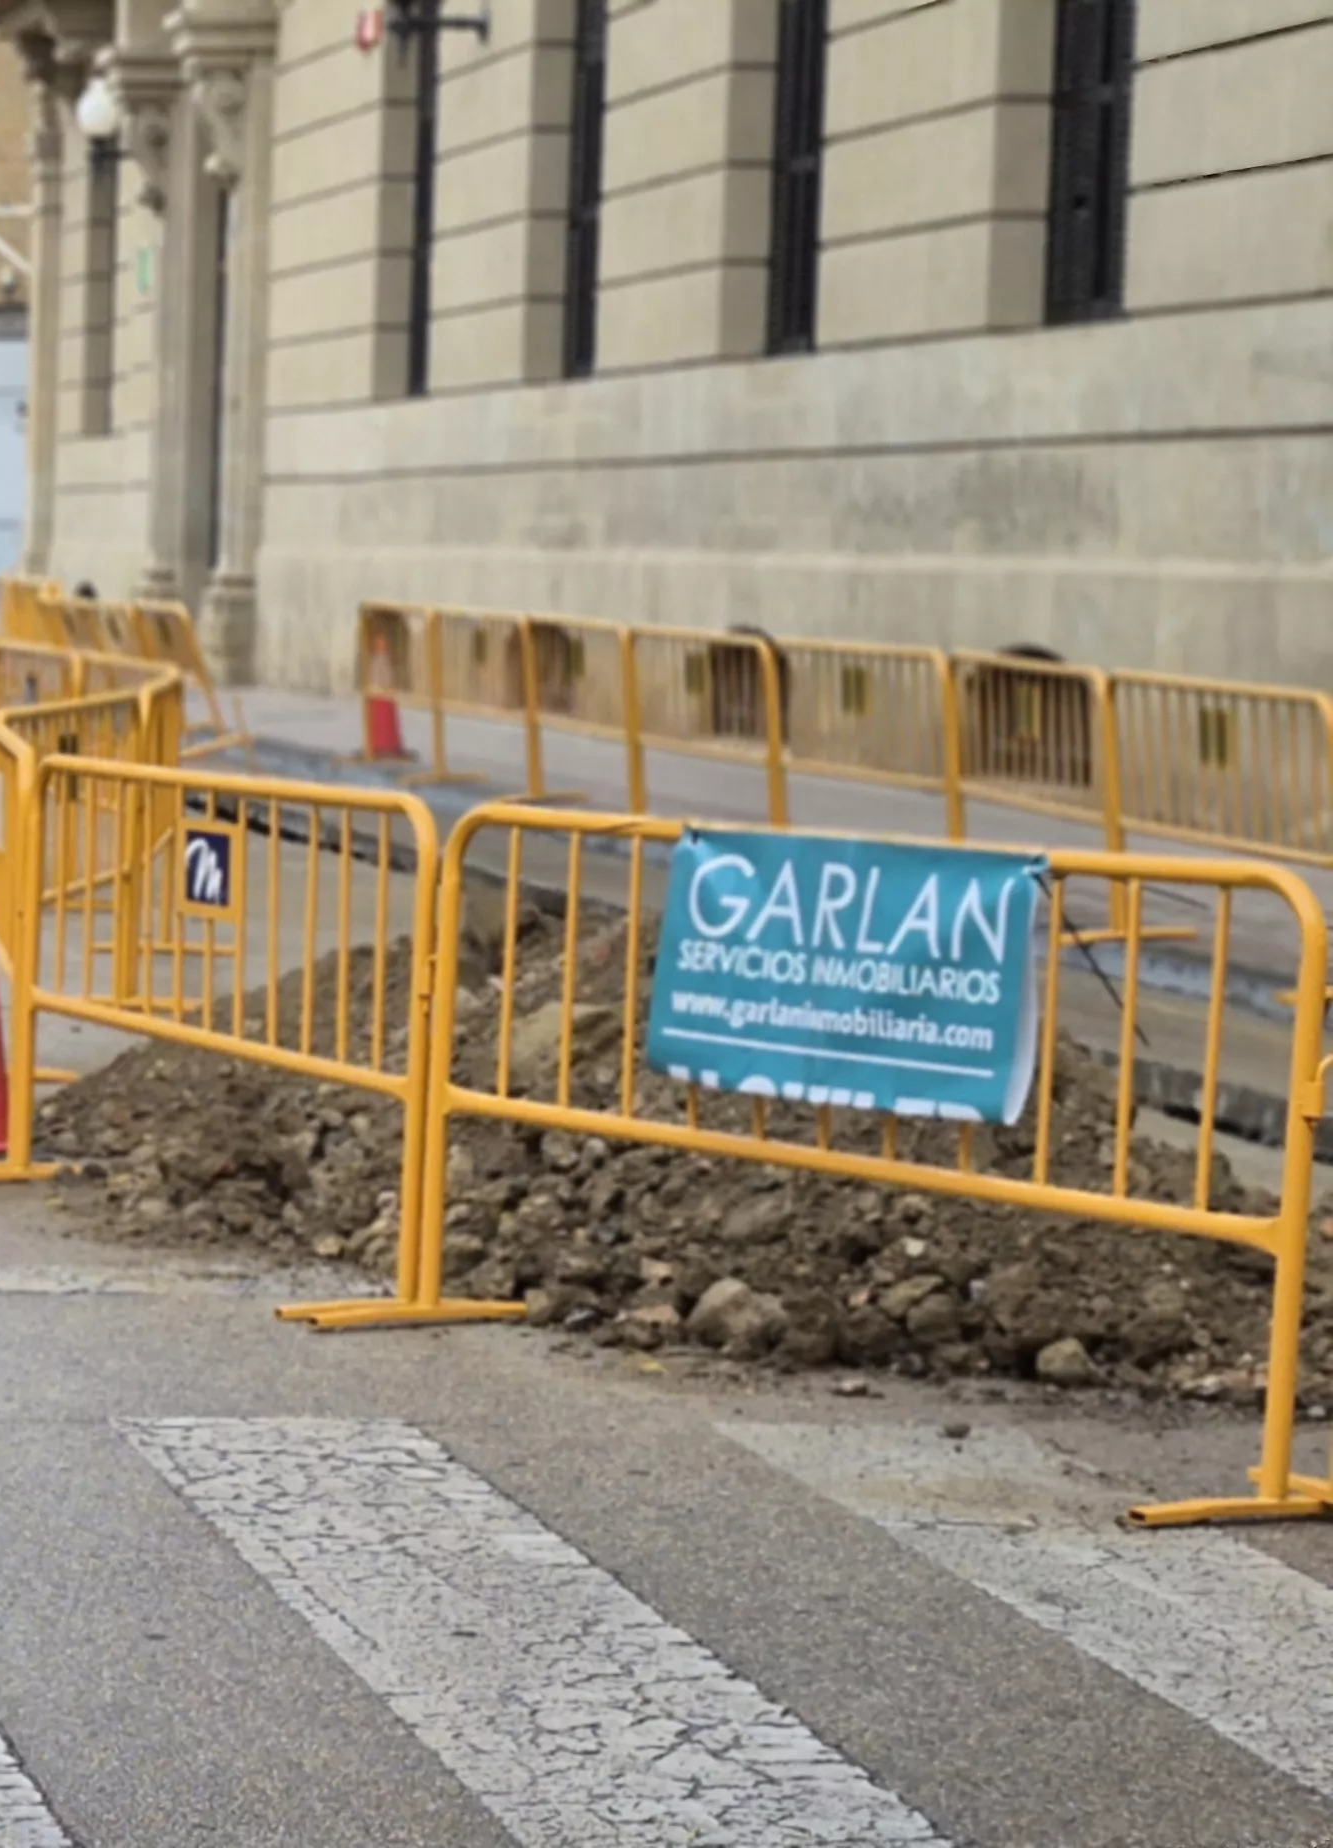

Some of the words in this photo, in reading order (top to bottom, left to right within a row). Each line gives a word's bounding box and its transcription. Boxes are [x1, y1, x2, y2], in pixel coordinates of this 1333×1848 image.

[688, 853, 1015, 964] GARLAN
[676, 939, 807, 986] SERVICIOS
[811, 958, 1002, 1006] INMOBILIARIOS
